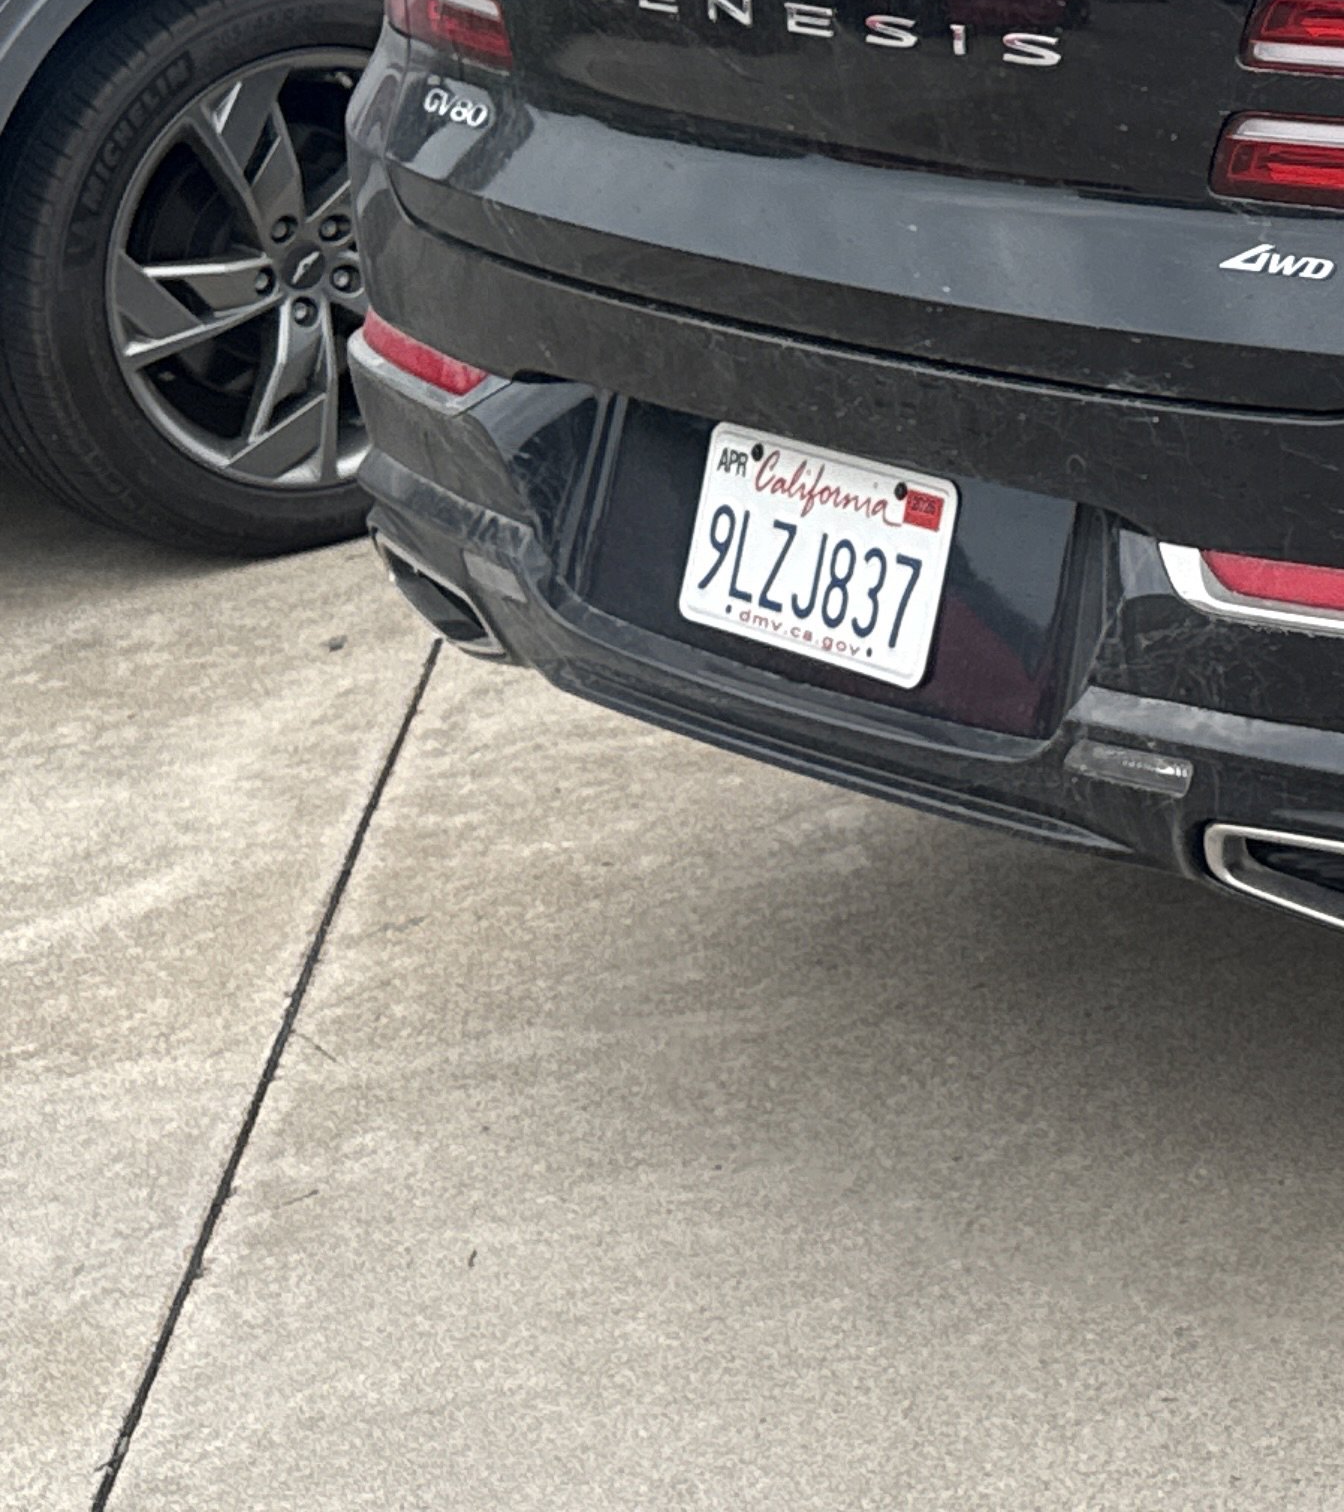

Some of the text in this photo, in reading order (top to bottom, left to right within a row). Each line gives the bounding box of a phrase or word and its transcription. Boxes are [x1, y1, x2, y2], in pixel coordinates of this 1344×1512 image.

[79, 54, 193, 211] MICHELIN
[423, 87, 488, 127] GV80
[716, 447, 749, 478] APR
[754, 450, 903, 528] California
[697, 503, 924, 649] 9LZJ837
[738, 609, 861, 657] dmv.ca.gov
